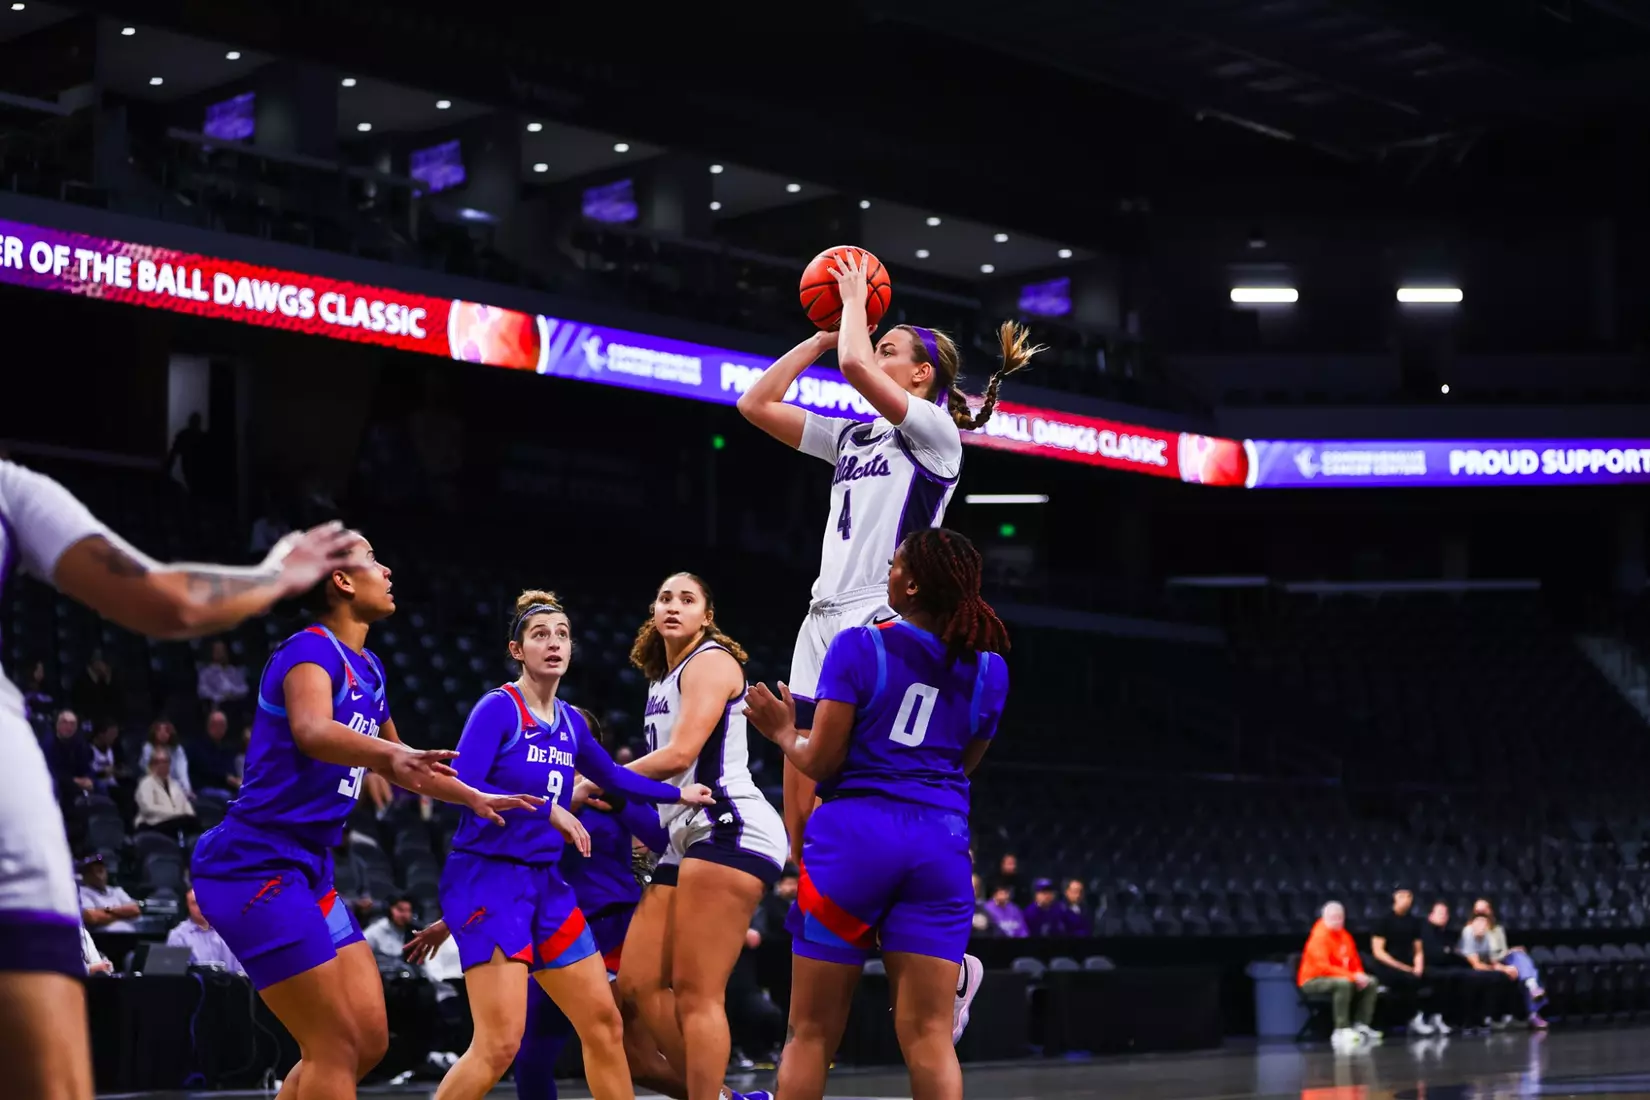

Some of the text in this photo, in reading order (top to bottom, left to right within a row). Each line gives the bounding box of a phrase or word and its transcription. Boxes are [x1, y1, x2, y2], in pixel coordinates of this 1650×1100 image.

[29, 241, 70, 276] OF
[75, 248, 132, 289] THE
[137, 260, 209, 302] BALL
[213, 272, 316, 320] DAWGS
[318, 292, 427, 339] CLASSIC
[1449, 448, 1650, 476] PROUD SUPPORT
[837, 488, 852, 541] 4
[889, 682, 940, 747] 0
[543, 769, 564, 804] 9
